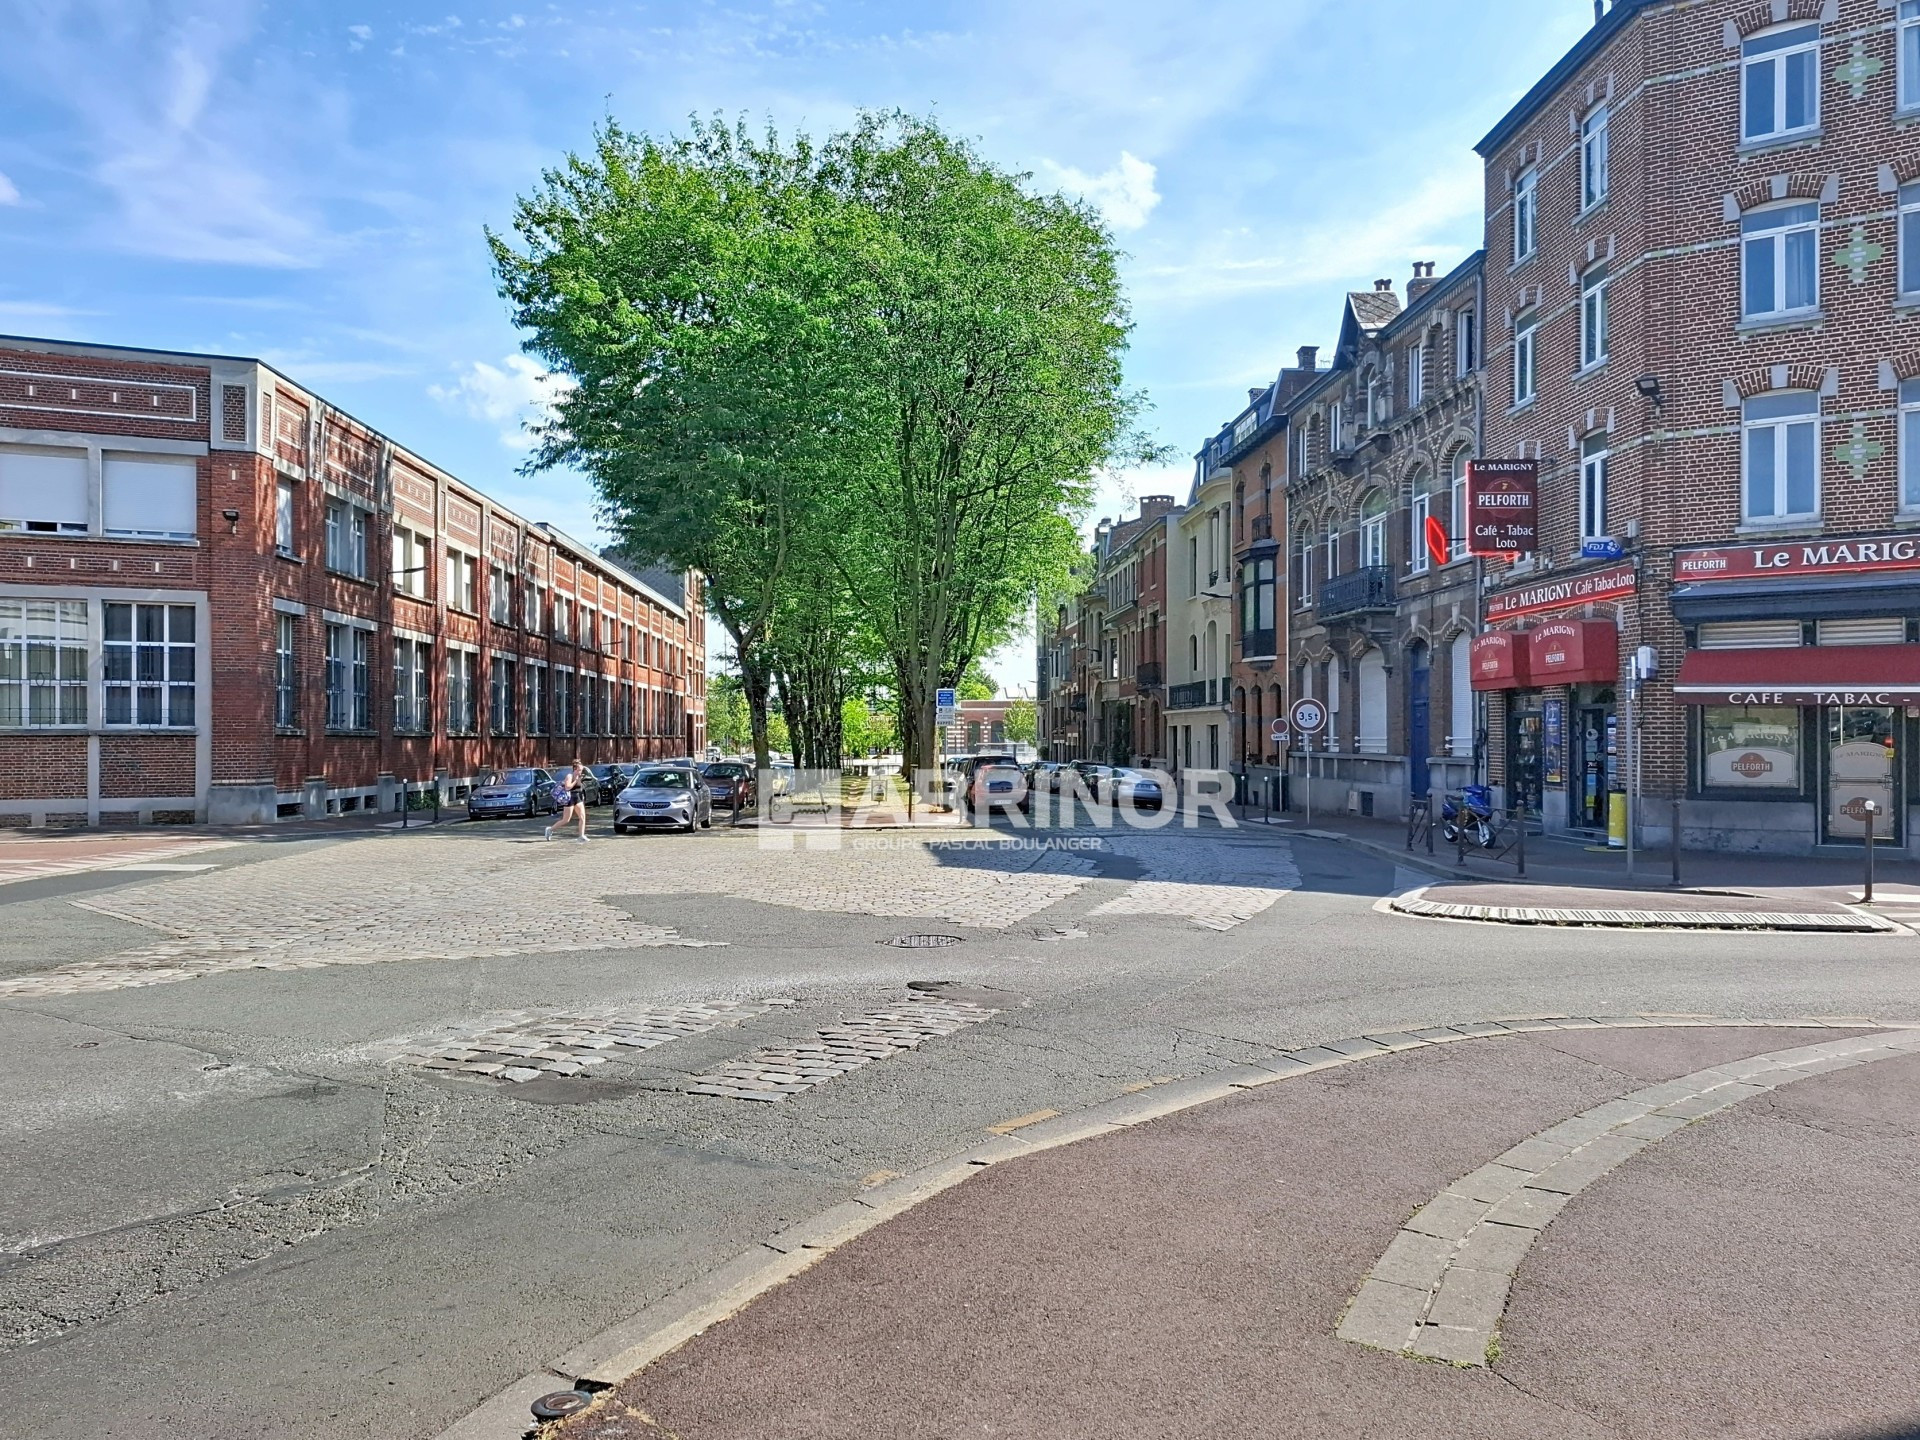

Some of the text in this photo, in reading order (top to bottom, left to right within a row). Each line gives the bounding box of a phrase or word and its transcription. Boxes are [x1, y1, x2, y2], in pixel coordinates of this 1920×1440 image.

[1474, 463, 1534, 471] Le MARIGNY
[1478, 494, 1529, 506] PELFORTH
[1475, 524, 1497, 536] Café
[1506, 524, 1534, 536] Tabac
[1496, 537, 1517, 548] Loto
[1588, 543, 1605, 551] FDJ
[1753, 540, 1920, 569] Le MARIG
[1681, 558, 1726, 571] PELFORTH
[1504, 573, 1635, 611] Le MARIGNY Café Tabac Loto
[1535, 625, 1576, 643] Le MARIGNY
[1480, 636, 1507, 648] MARIGNY
[1545, 653, 1565, 664] PELFORTH
[1728, 693, 1784, 704] CAFE
[1813, 693, 1890, 705] TABAC
[1298, 711, 1319, 722] 3,5 t
[1732, 762, 1770, 771] PELFORTH
[1841, 806, 1880, 814] PELFOH
